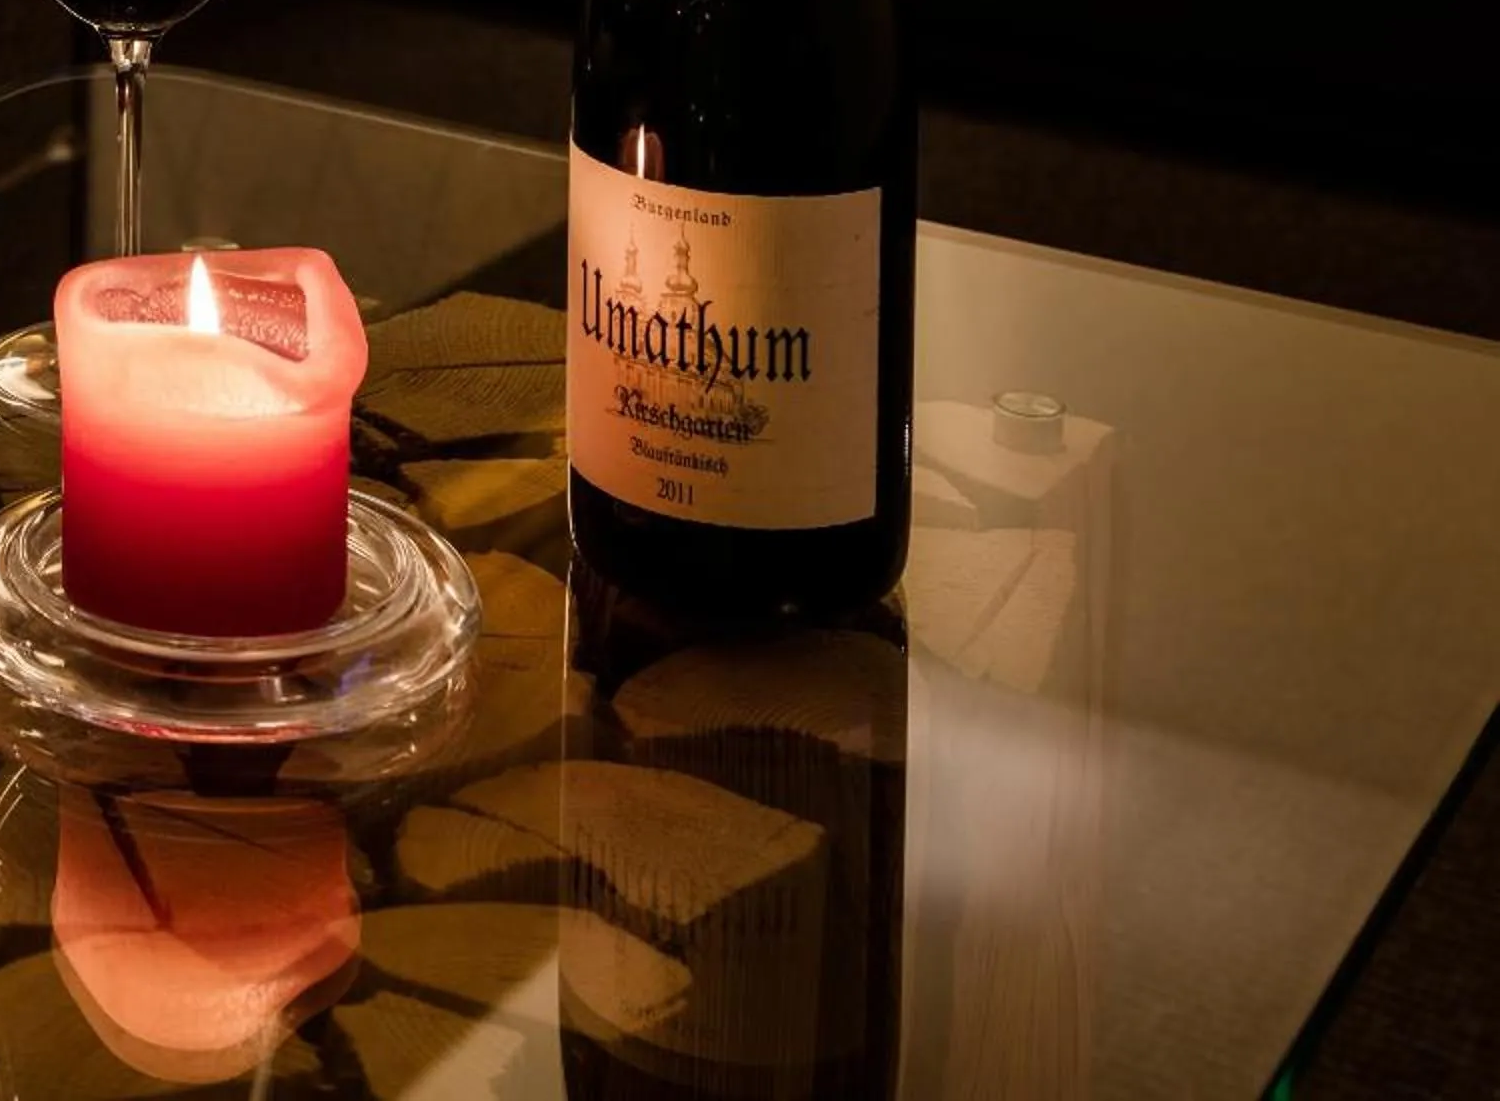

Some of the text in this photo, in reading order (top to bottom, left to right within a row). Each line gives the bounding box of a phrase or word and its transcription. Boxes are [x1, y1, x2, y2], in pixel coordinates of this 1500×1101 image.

[632, 194, 732, 227] Burgenland
[581, 259, 812, 394] Umathum
[614, 385, 752, 442] Kirschgarten
[656, 477, 694, 506] 2011
